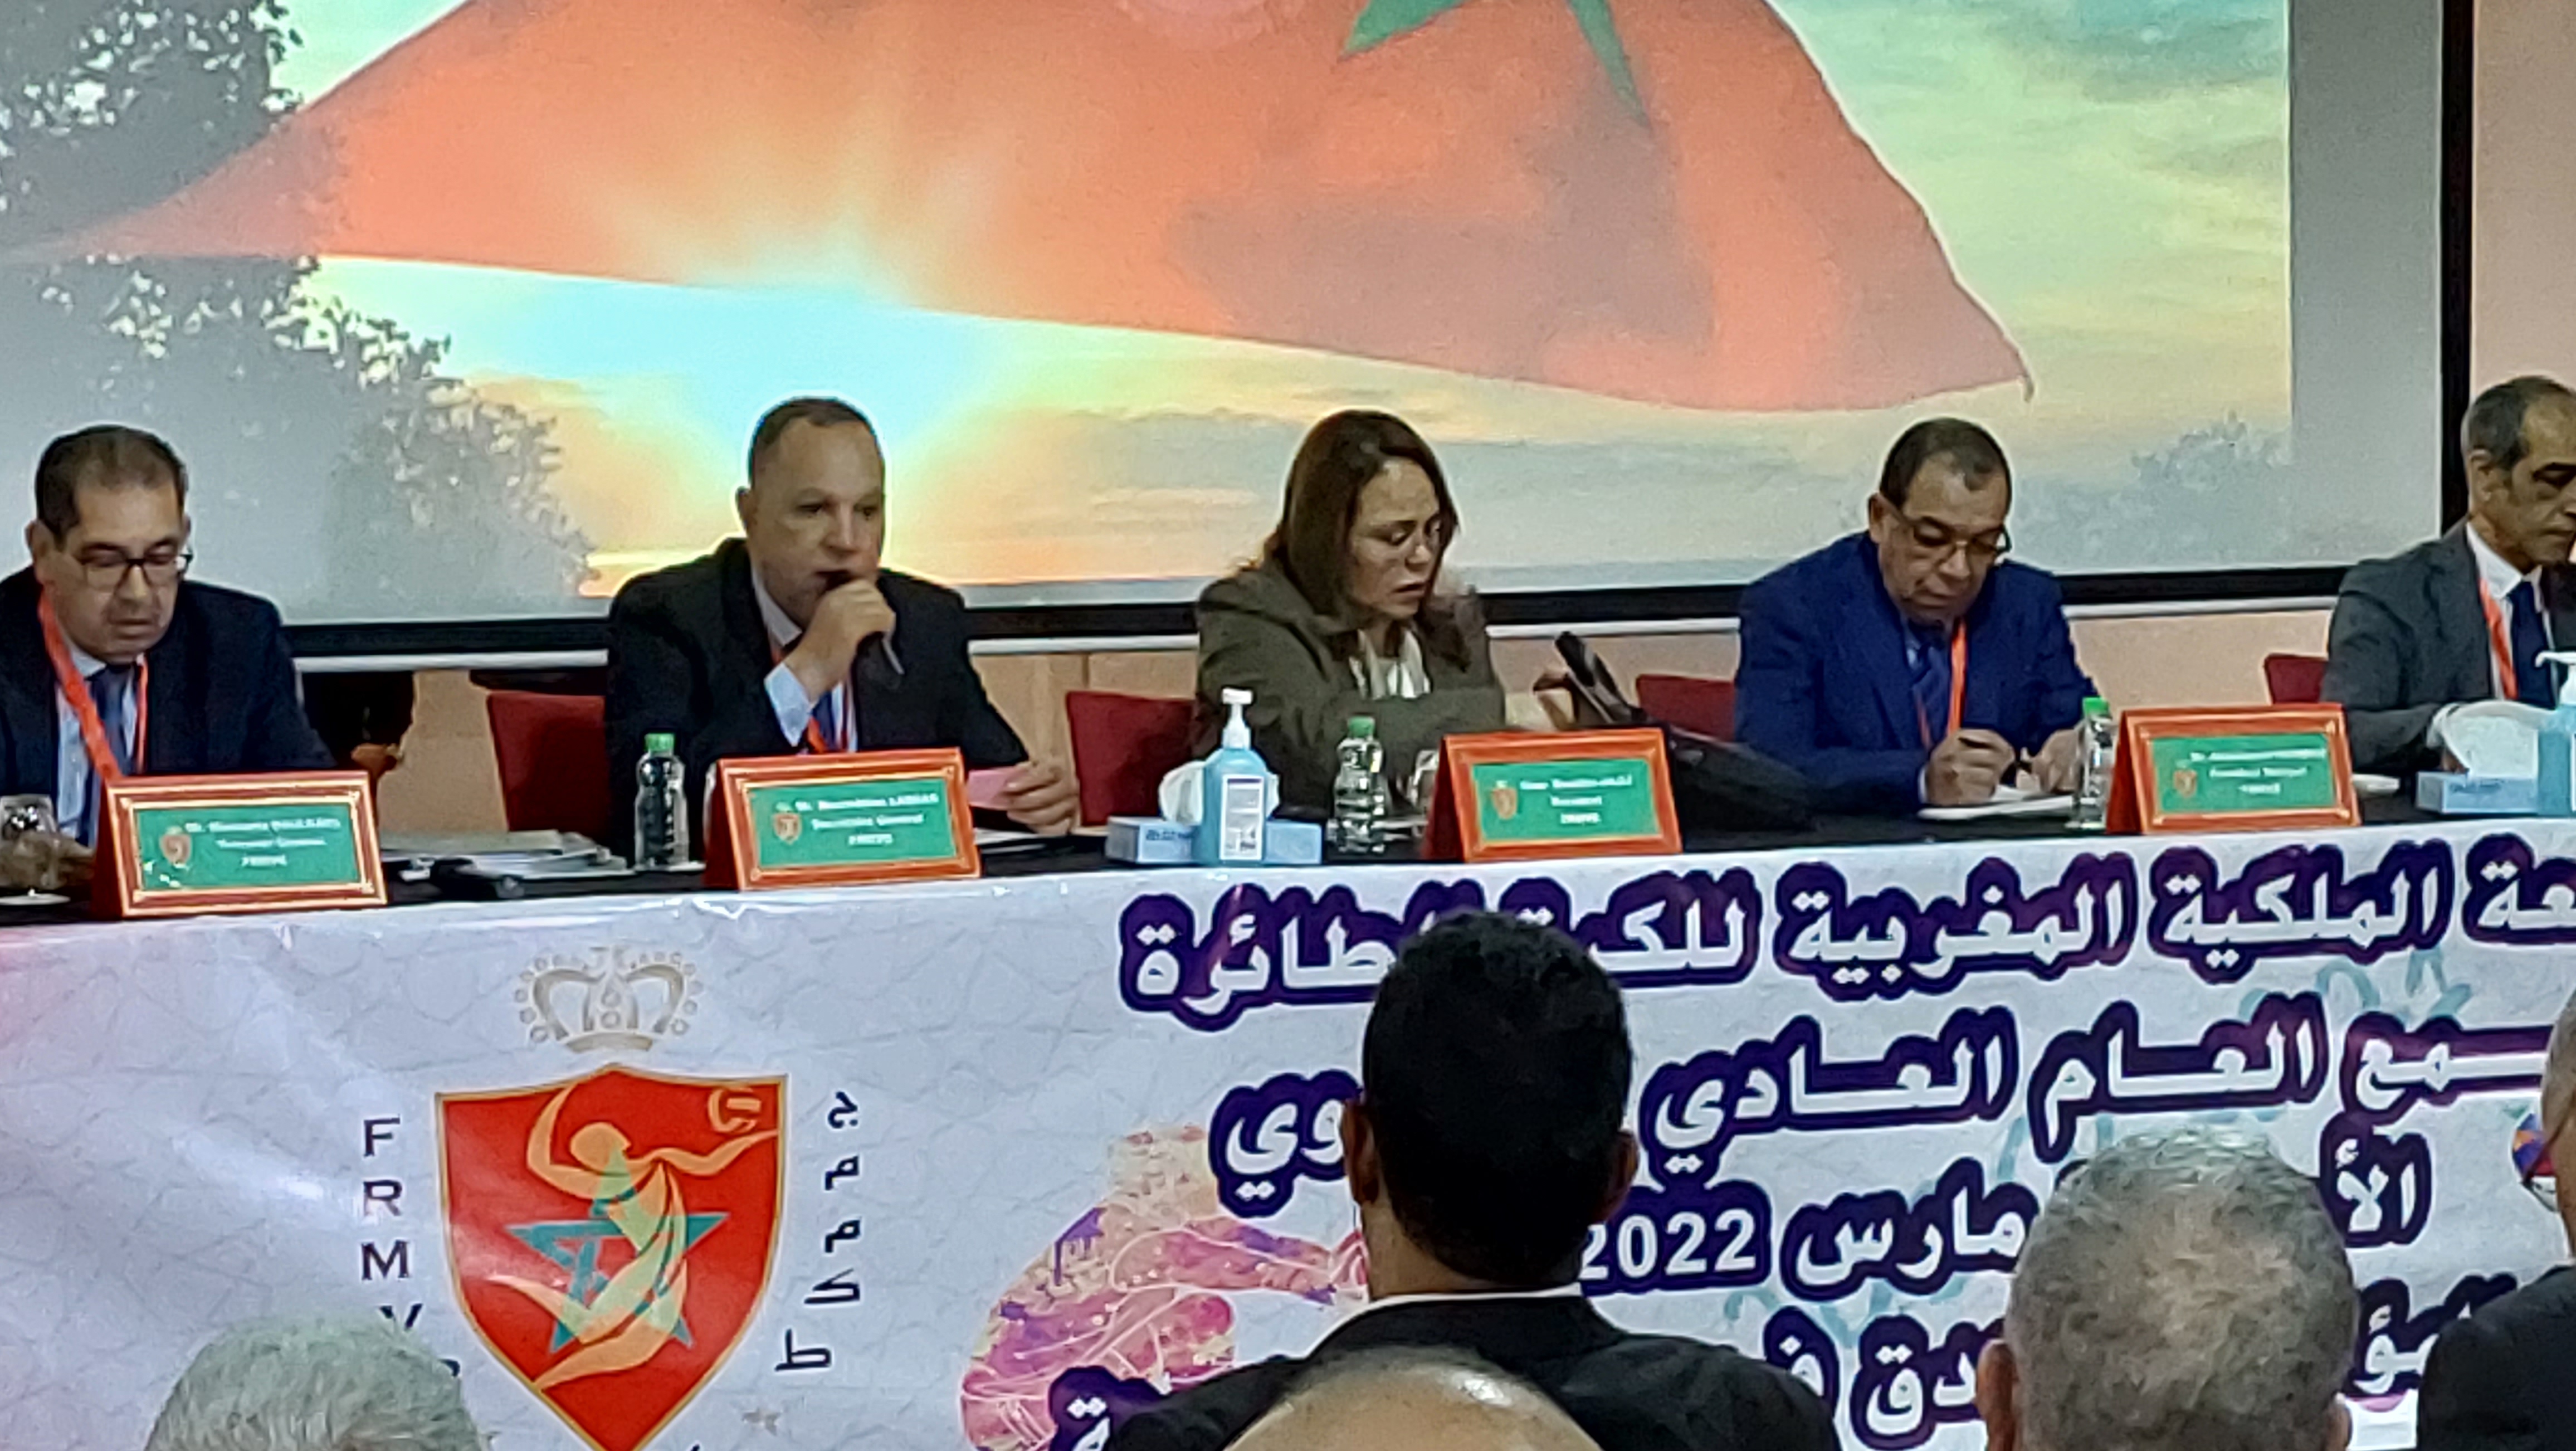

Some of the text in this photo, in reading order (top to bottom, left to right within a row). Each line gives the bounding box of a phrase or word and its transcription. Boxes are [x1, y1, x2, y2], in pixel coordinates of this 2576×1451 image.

[1789, 879, 2124, 984] المغربية
[2164, 866, 2439, 968] الملكية
[1655, 1034, 2003, 1175] العادي
[2045, 1020, 2315, 1148] العام
[1580, 1209, 1757, 1279] 2022
[1796, 1187, 2027, 1286] مارس
